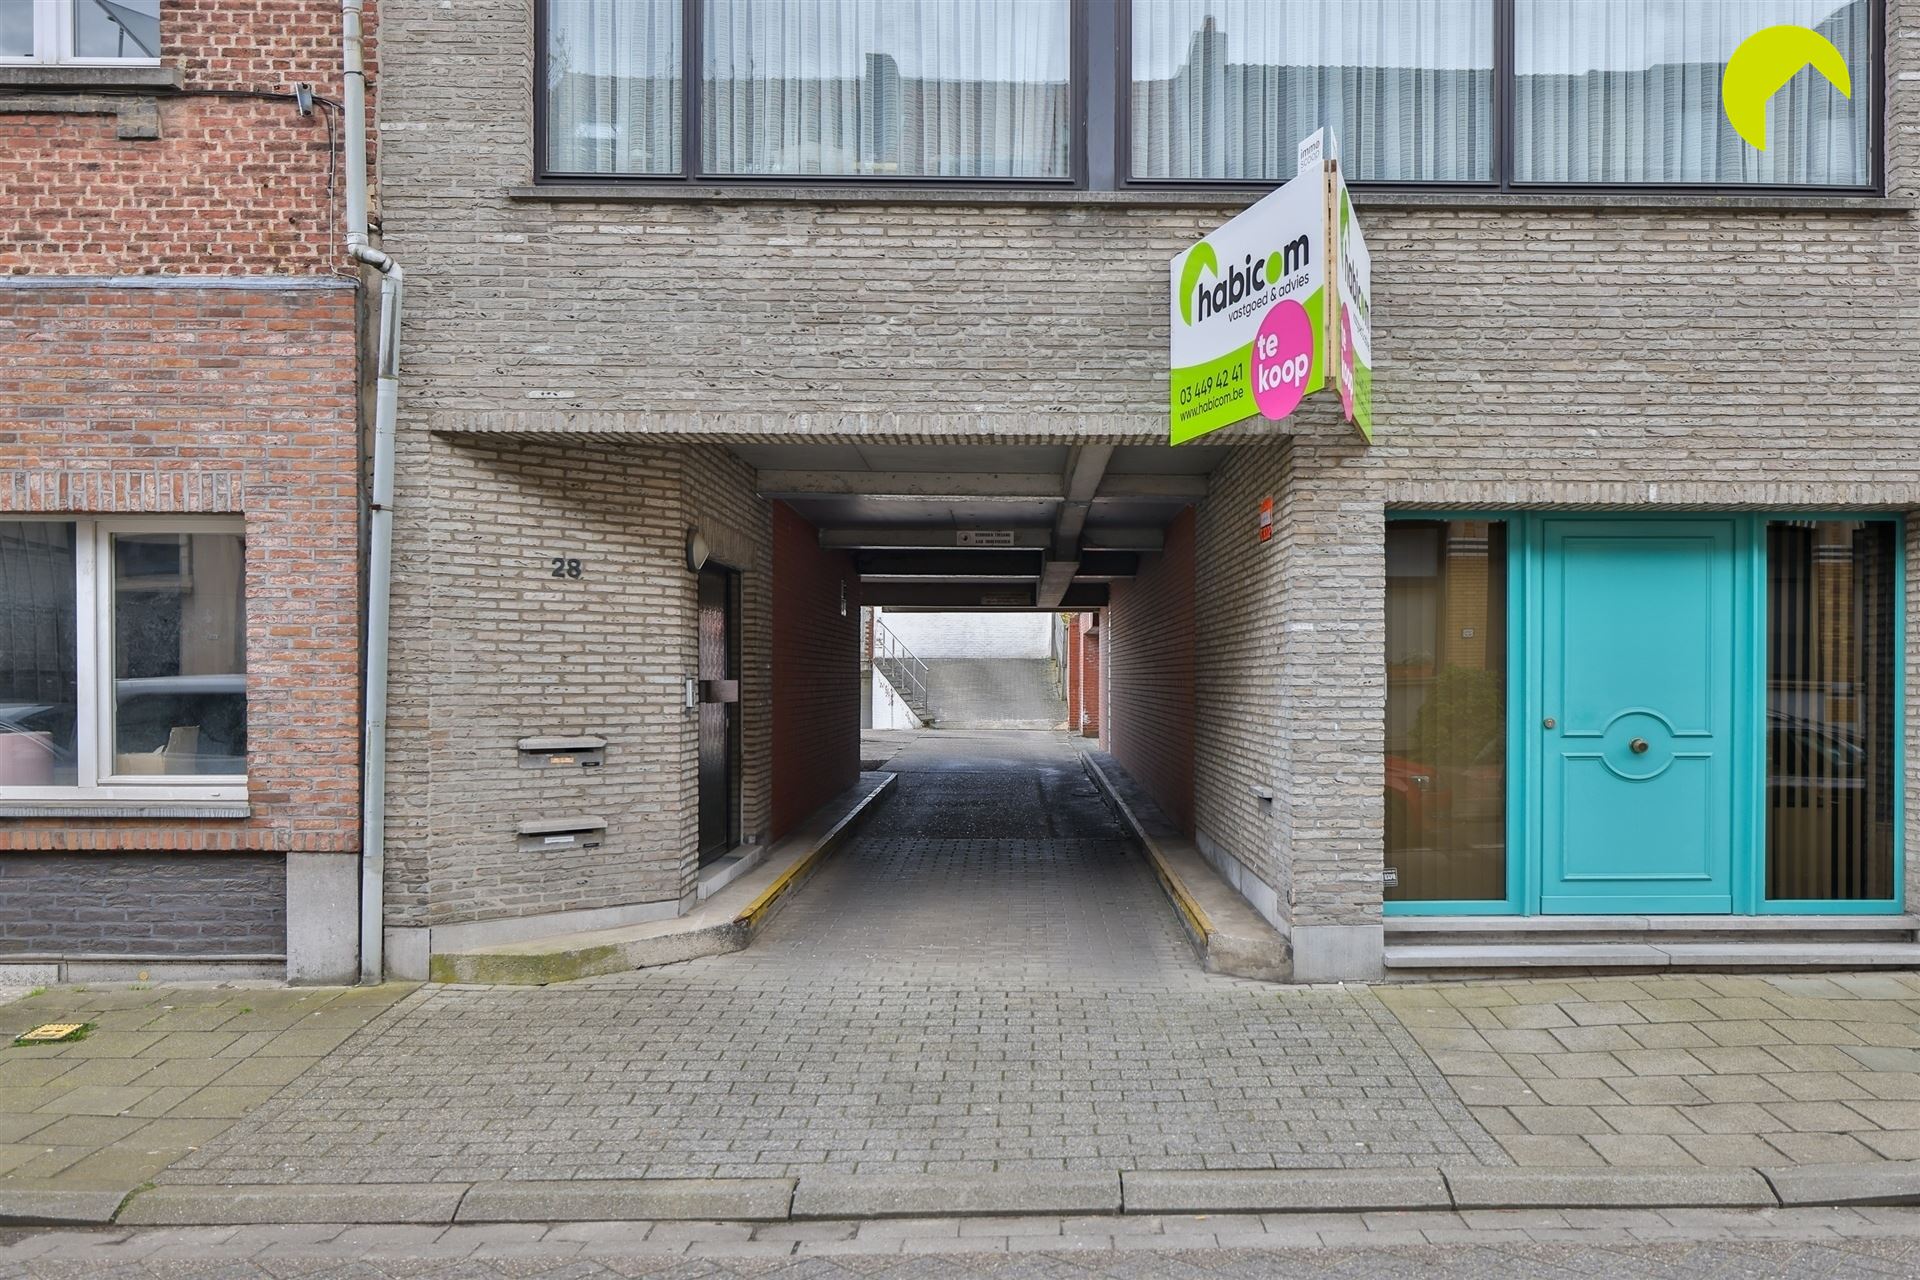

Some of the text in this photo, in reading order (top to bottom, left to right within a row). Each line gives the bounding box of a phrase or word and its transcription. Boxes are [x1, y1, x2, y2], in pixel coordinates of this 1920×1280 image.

[1198, 234, 1310, 322] habicom
[1228, 273, 1310, 323] vastgoed & advies
[1257, 333, 1279, 361] te
[1180, 362, 1243, 405] 03 449 42 41
[1258, 353, 1309, 393] koop
[1180, 387, 1244, 422] www.habicom.be
[551, 557, 582, 580] 28
